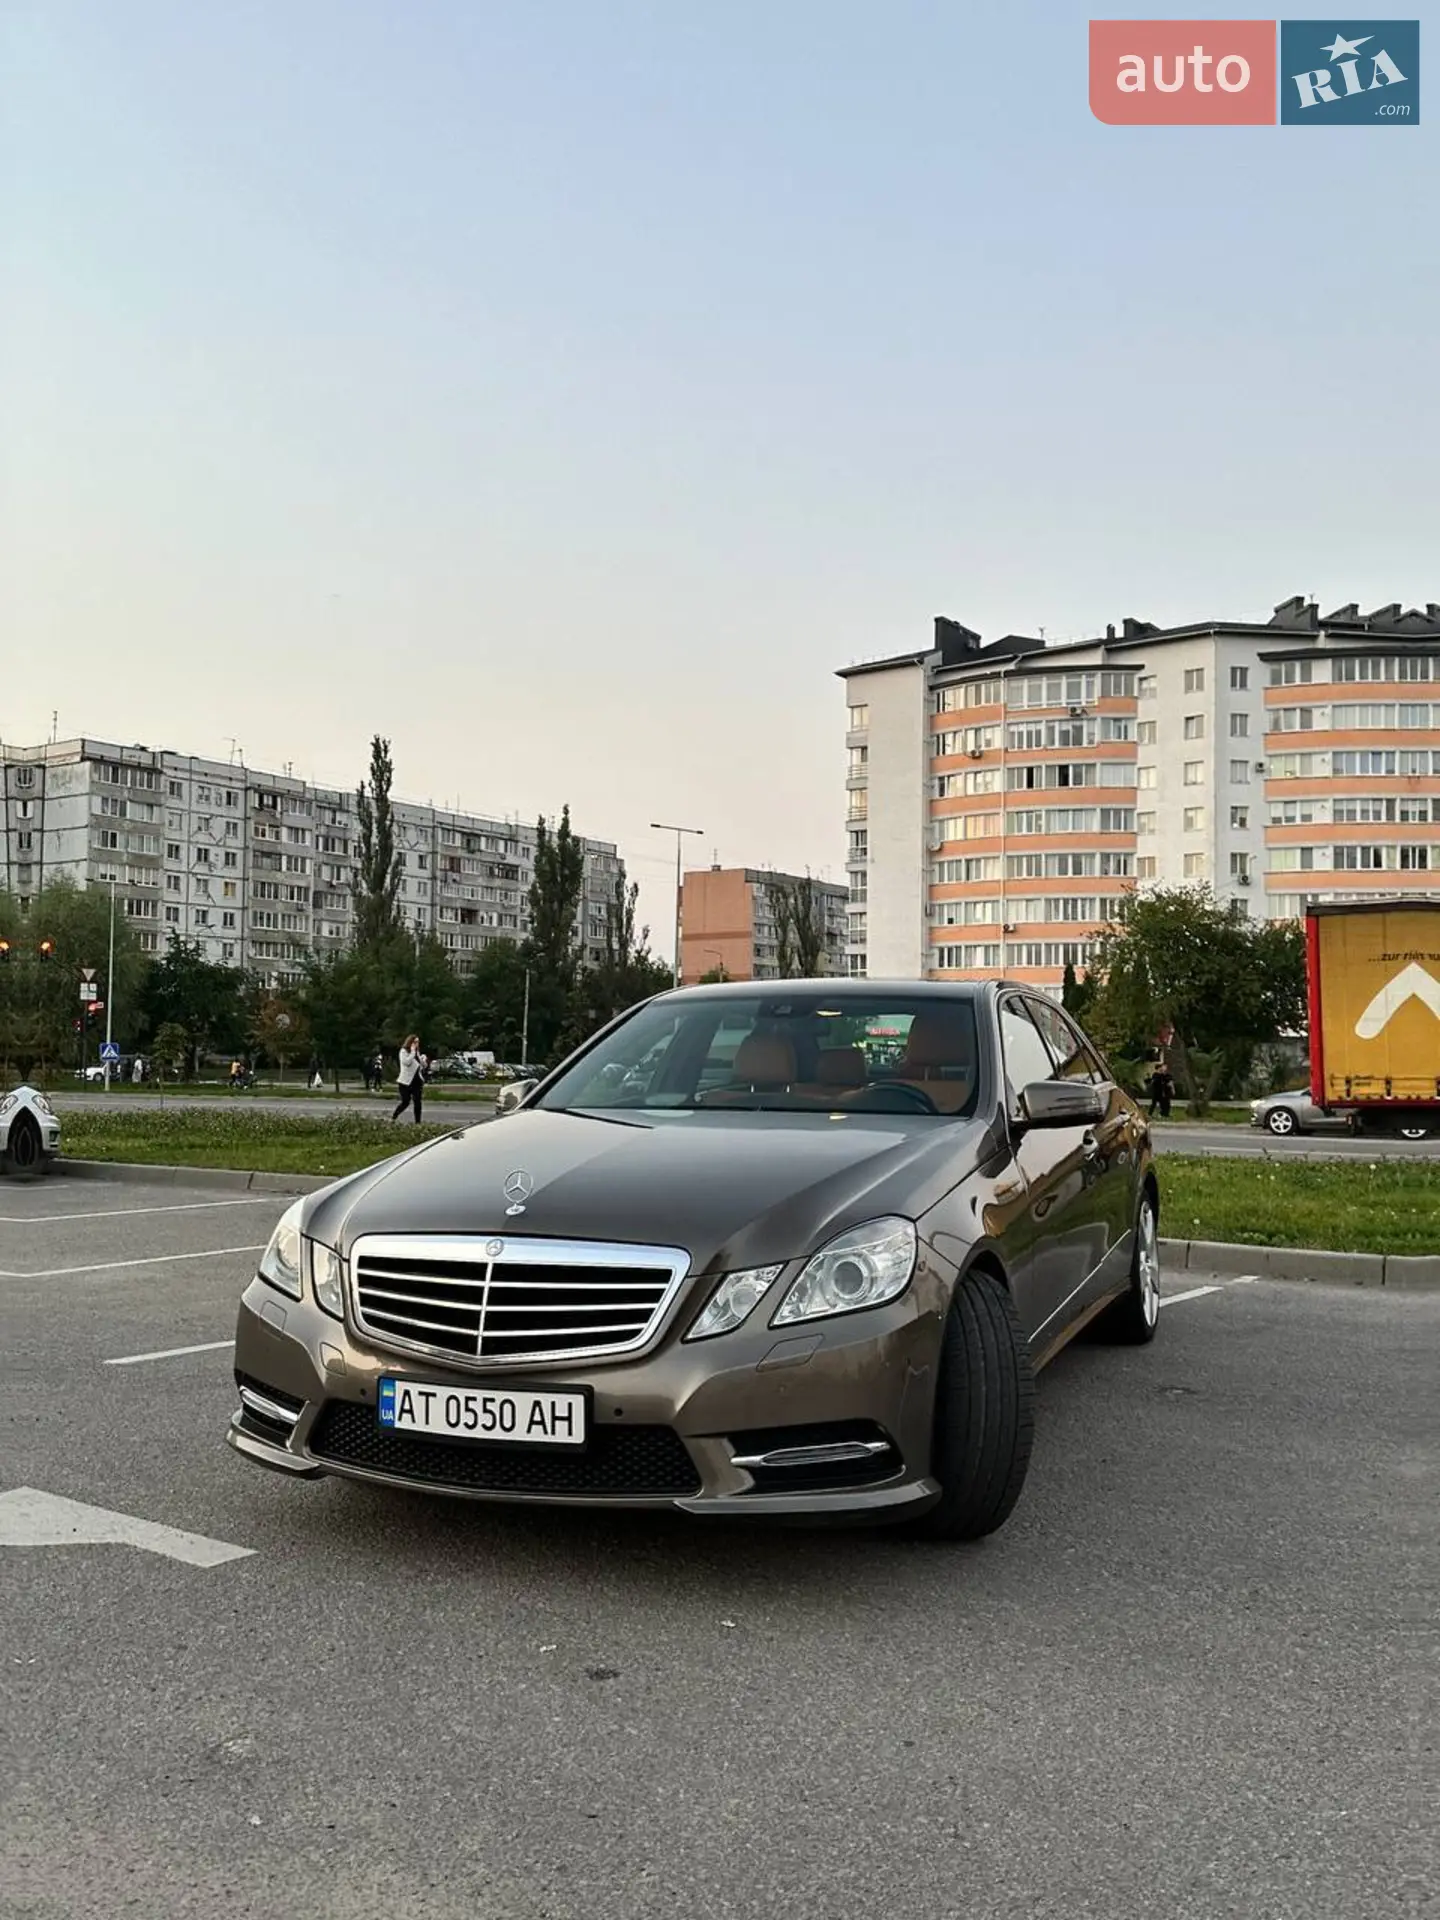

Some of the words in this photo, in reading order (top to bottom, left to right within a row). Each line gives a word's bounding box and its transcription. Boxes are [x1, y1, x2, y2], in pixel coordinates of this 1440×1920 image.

[382, 1409, 395, 1420] UA
[397, 1389, 437, 1425] AT
[445, 1394, 516, 1433] 0550
[526, 1400, 573, 1436] AH
